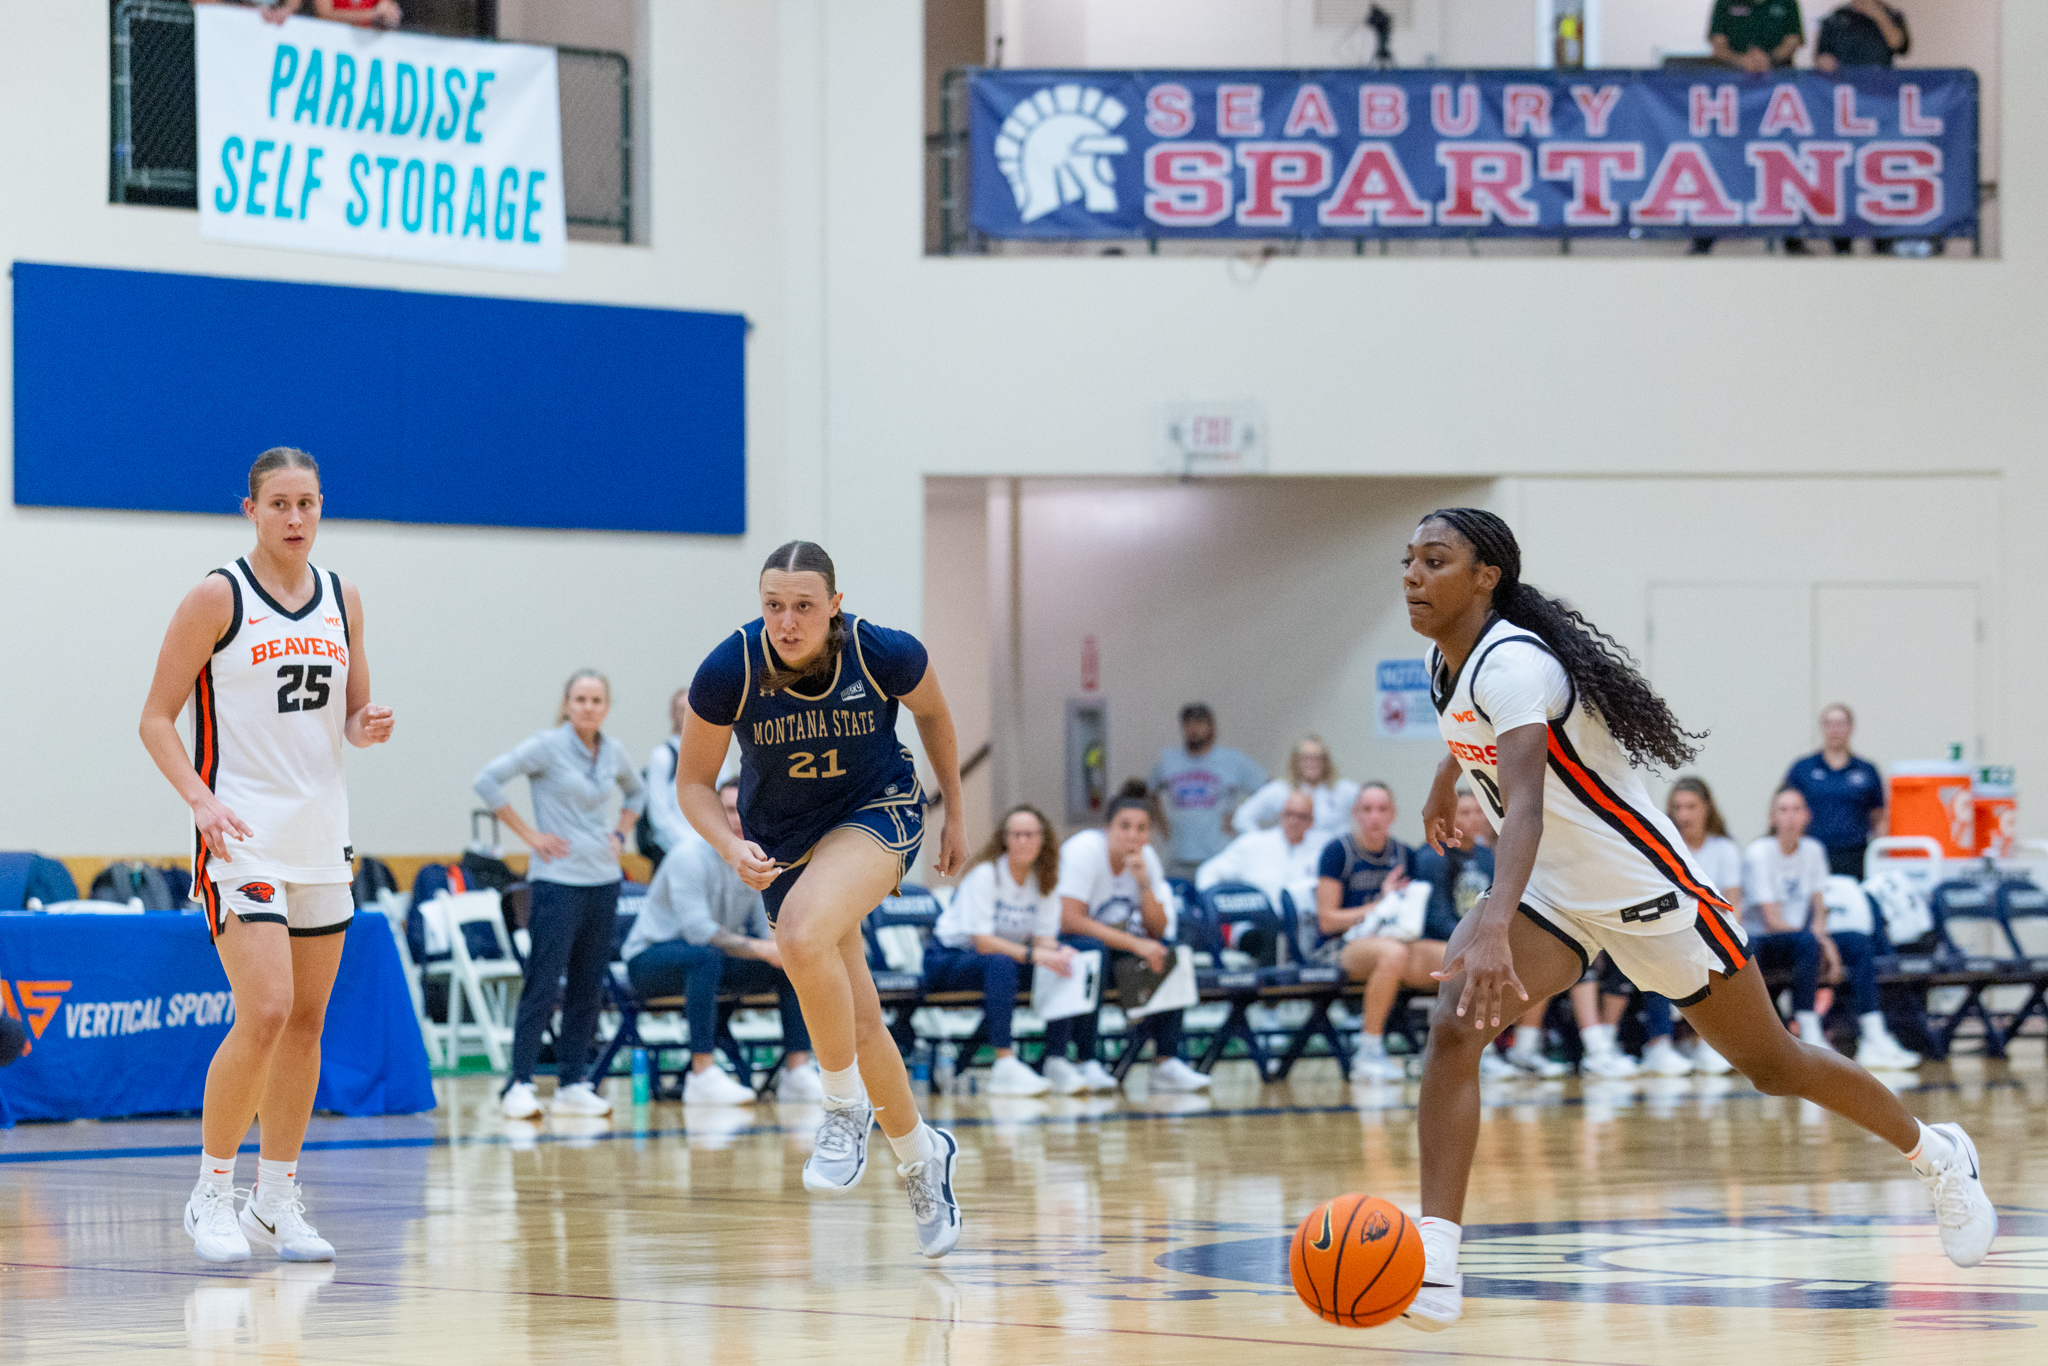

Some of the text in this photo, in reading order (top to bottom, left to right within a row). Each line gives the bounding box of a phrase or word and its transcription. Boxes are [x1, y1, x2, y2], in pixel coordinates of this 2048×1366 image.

[269, 43, 496, 145] PARADISE
[1145, 83, 1944, 138] SEABURY HALL
[214, 136, 546, 244] SELF STORAGE
[1144, 141, 1944, 227] SPARTANS
[251, 637, 347, 666] BEAVERS
[277, 664, 332, 713] 25
[753, 709, 876, 745] MONTANA STATE
[787, 748, 847, 779] 21
[65, 995, 163, 1039] VERTICAL
